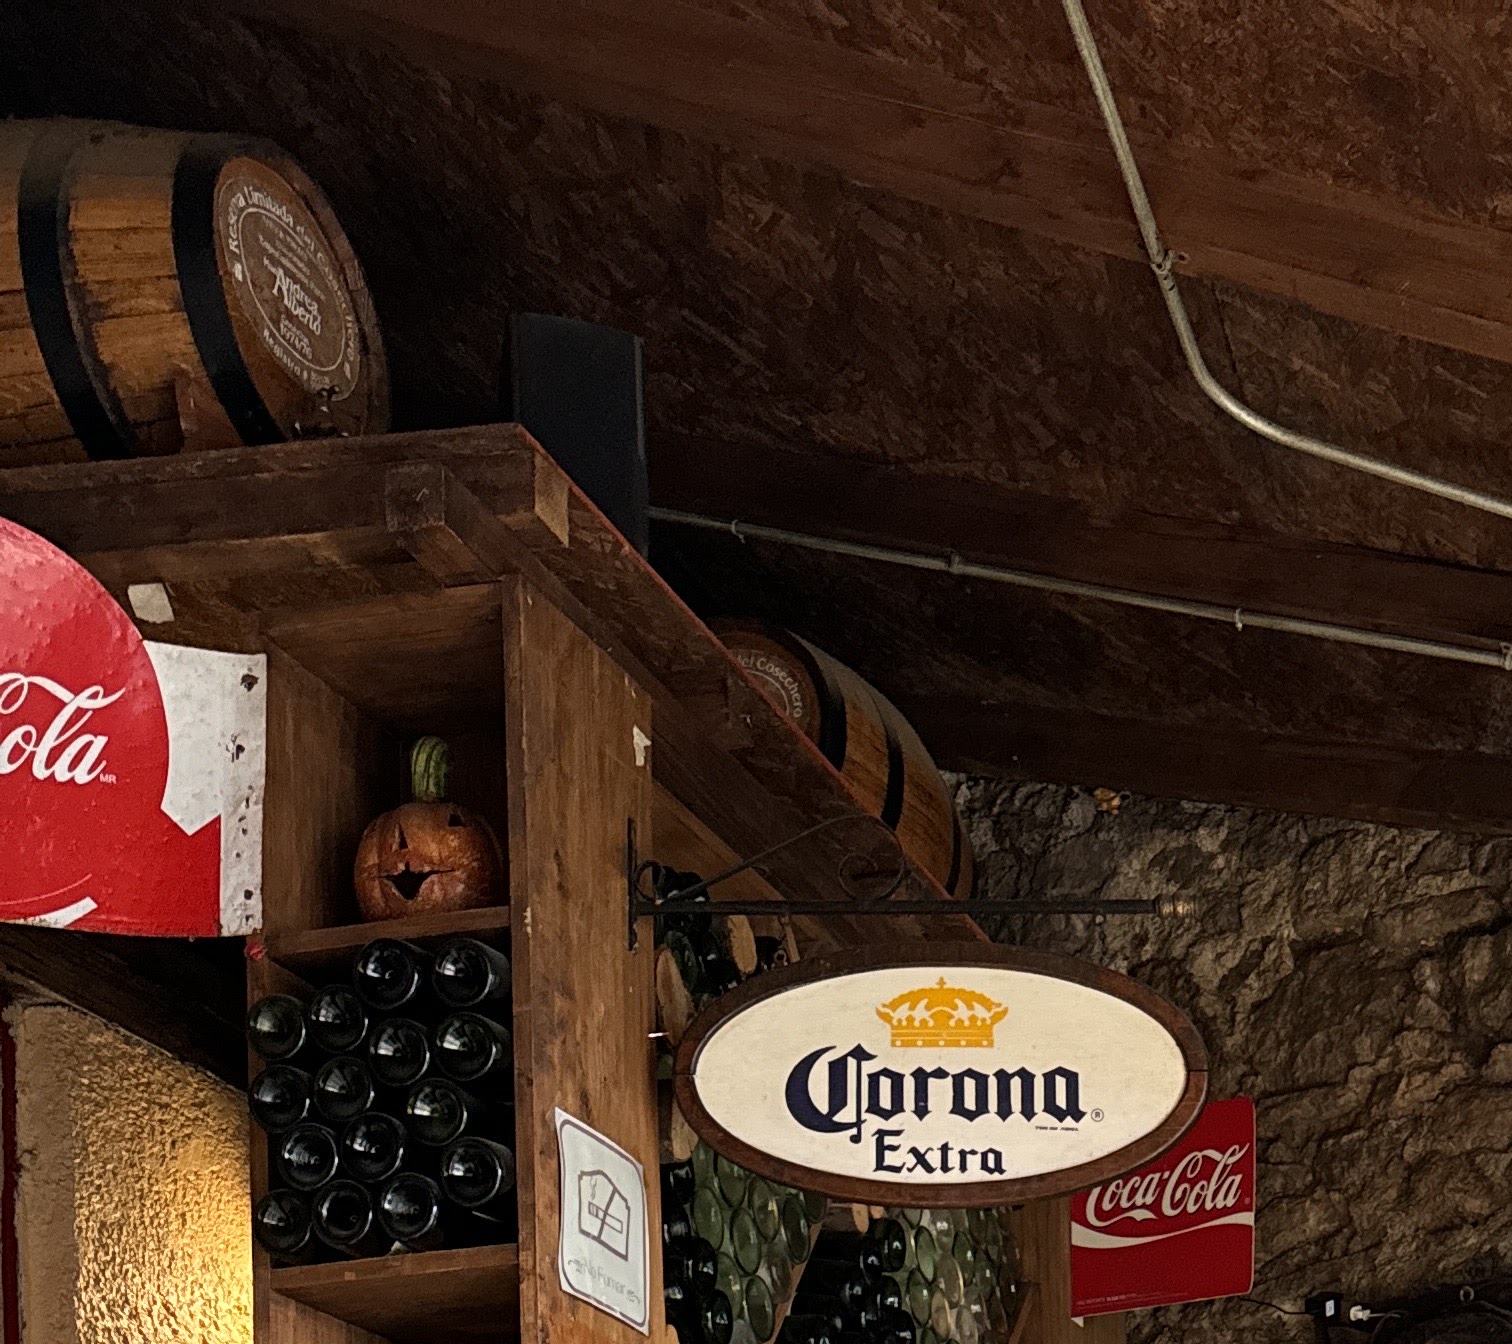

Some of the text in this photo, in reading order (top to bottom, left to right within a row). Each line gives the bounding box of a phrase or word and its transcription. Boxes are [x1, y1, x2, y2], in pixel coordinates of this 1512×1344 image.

[243, 185, 294, 227] Limitada
[756, 657, 803, 718] Cosechero
[0, 672, 126, 786] ola
[785, 1042, 1088, 1144] Corona
[871, 1128, 1008, 1175] Extra
[1085, 1142, 1250, 1228] Coca-Cola
